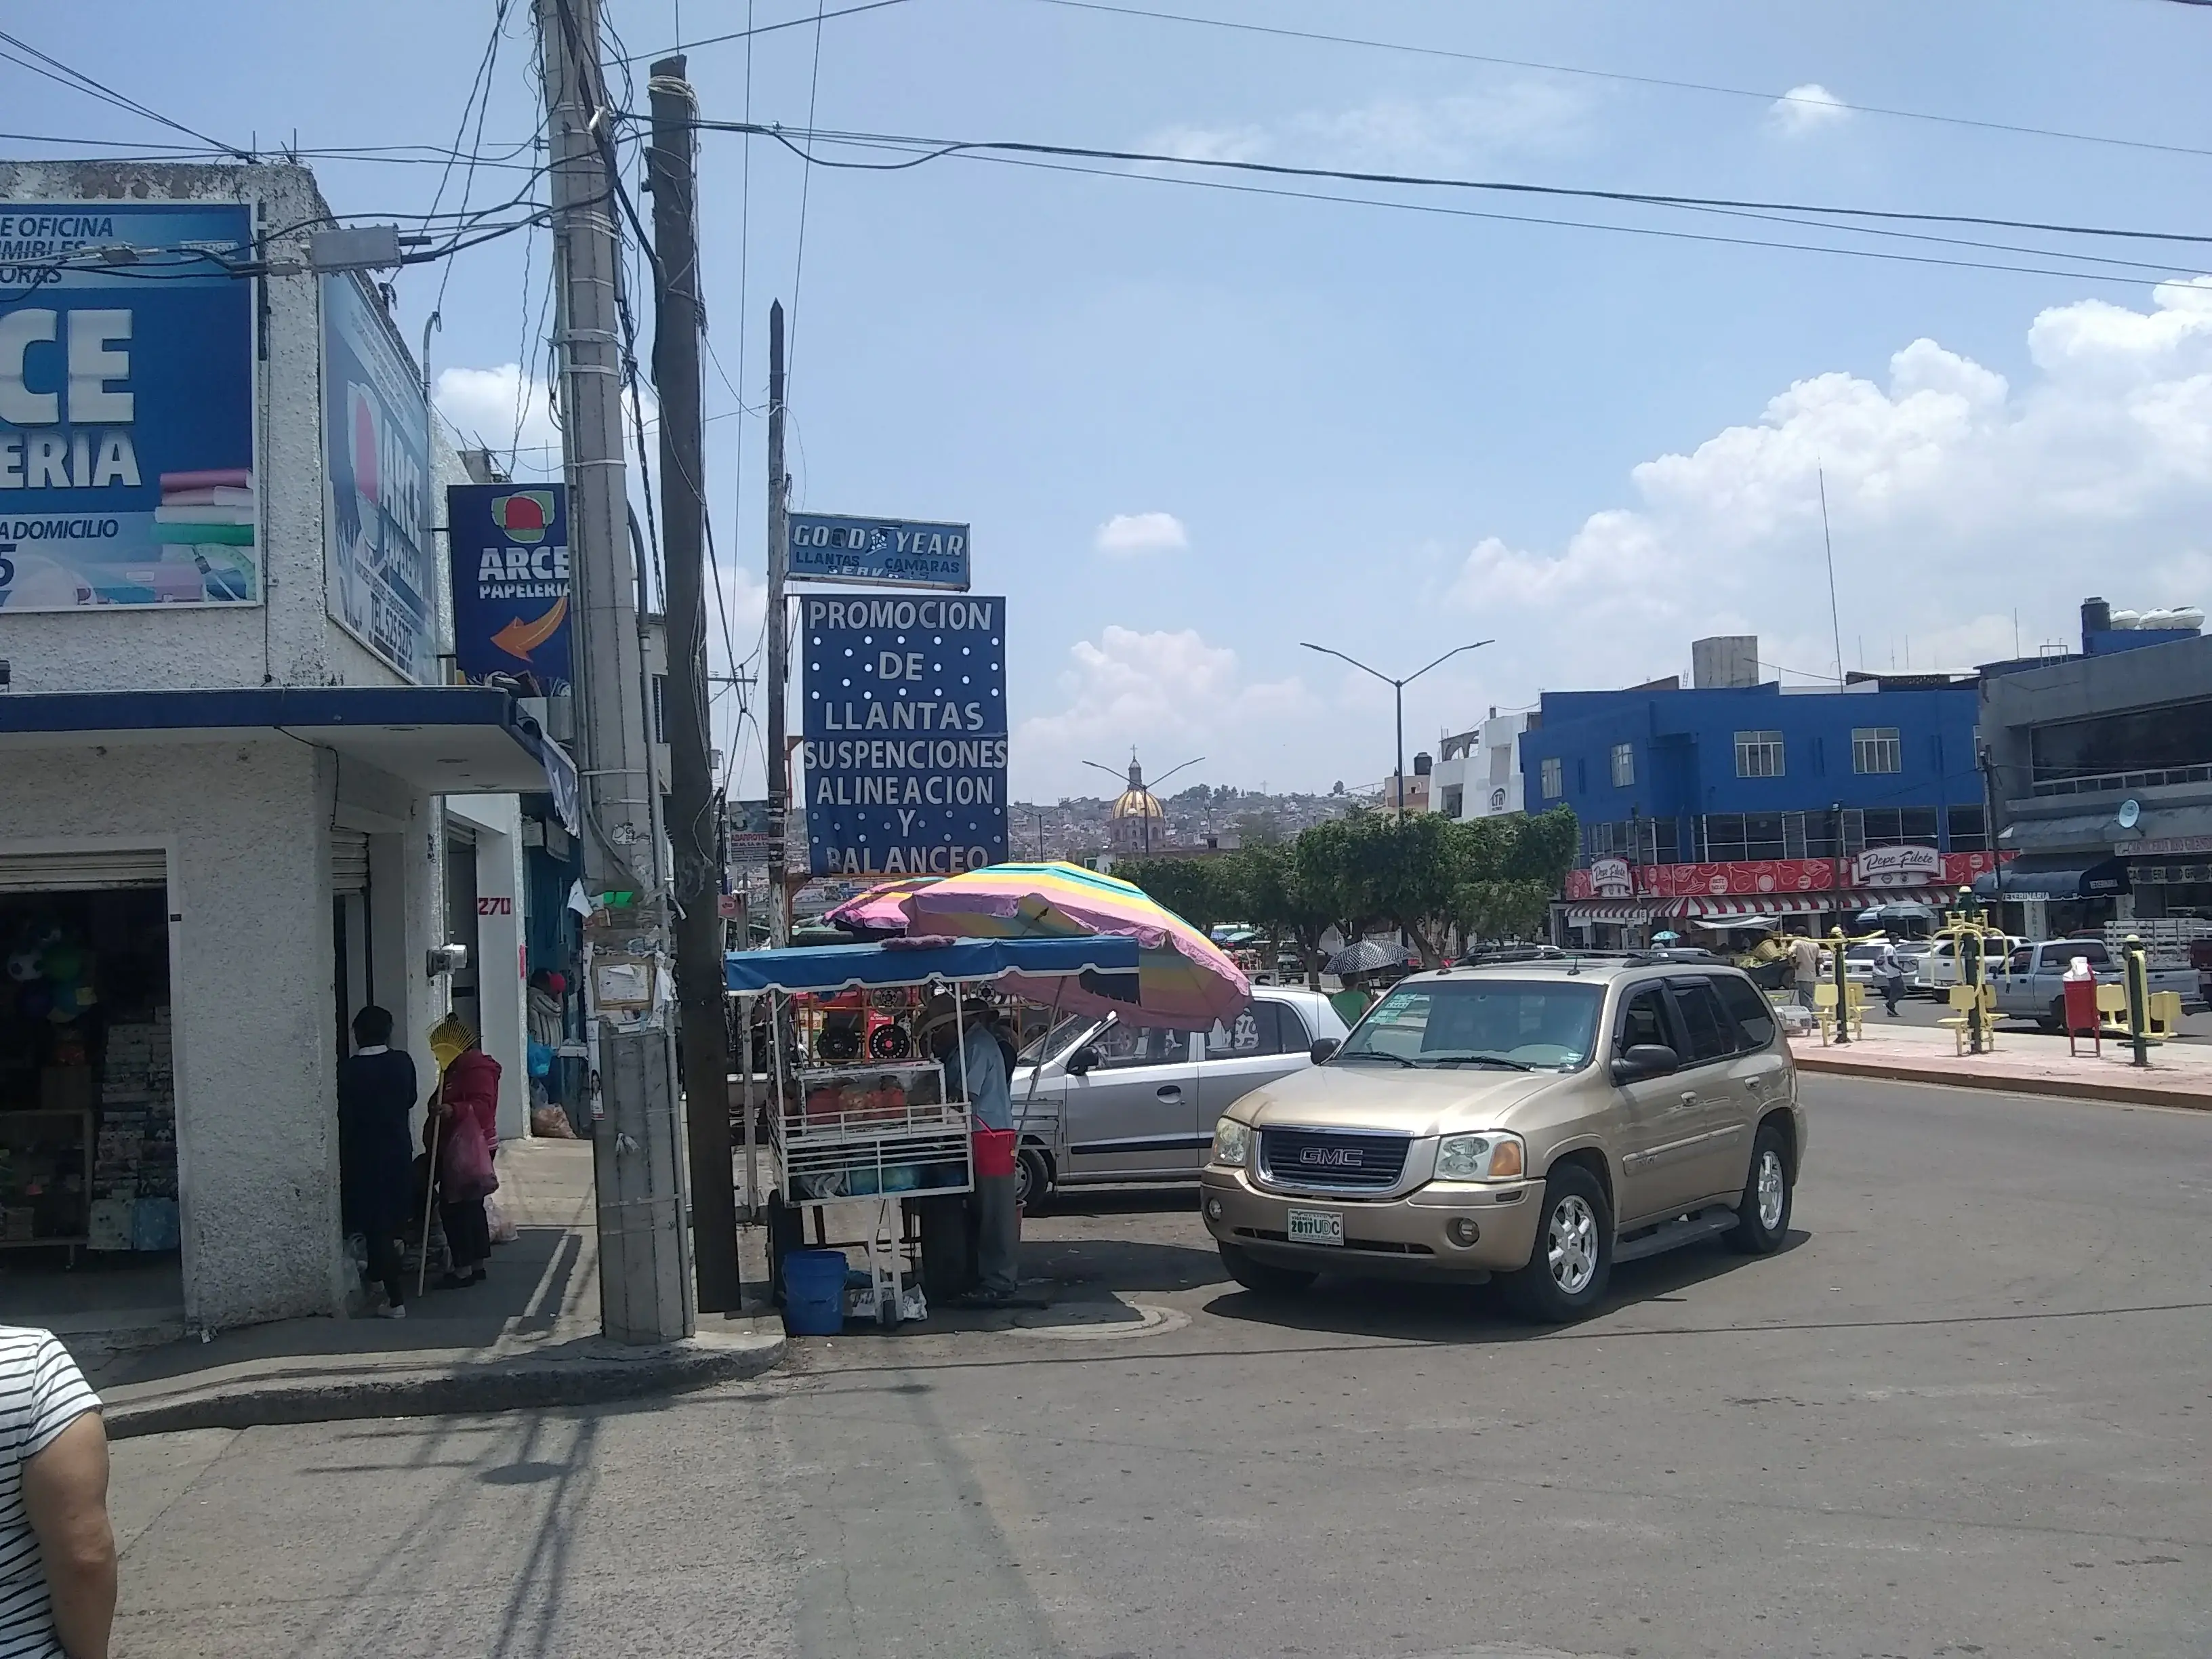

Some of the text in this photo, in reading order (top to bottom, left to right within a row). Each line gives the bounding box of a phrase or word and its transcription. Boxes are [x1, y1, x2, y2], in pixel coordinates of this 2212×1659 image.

[18, 216, 114, 237] OFICINA
[382, 417, 422, 554] ARCE
[12, 519, 119, 540] DOMICILIO
[895, 531, 964, 556] YEAR
[478, 546, 569, 581] ARCE
[796, 552, 960, 573] LLANTAS CAMARAS
[479, 583, 571, 600] PAPELERIA
[808, 600, 992, 631] PROMOCION
[878, 651, 924, 681] DE
[824, 701, 985, 731] LLANTAS
[804, 739, 1008, 770] SUSPENCIONES
[816, 775, 994, 806] ALINEACION
[897, 808, 917, 838] Y
[827, 845, 989, 874] BALANCEO
[1862, 851, 1933, 872] Pepe Filete
[478, 897, 511, 916] 270
[1299, 1146, 1364, 1167] GMC
